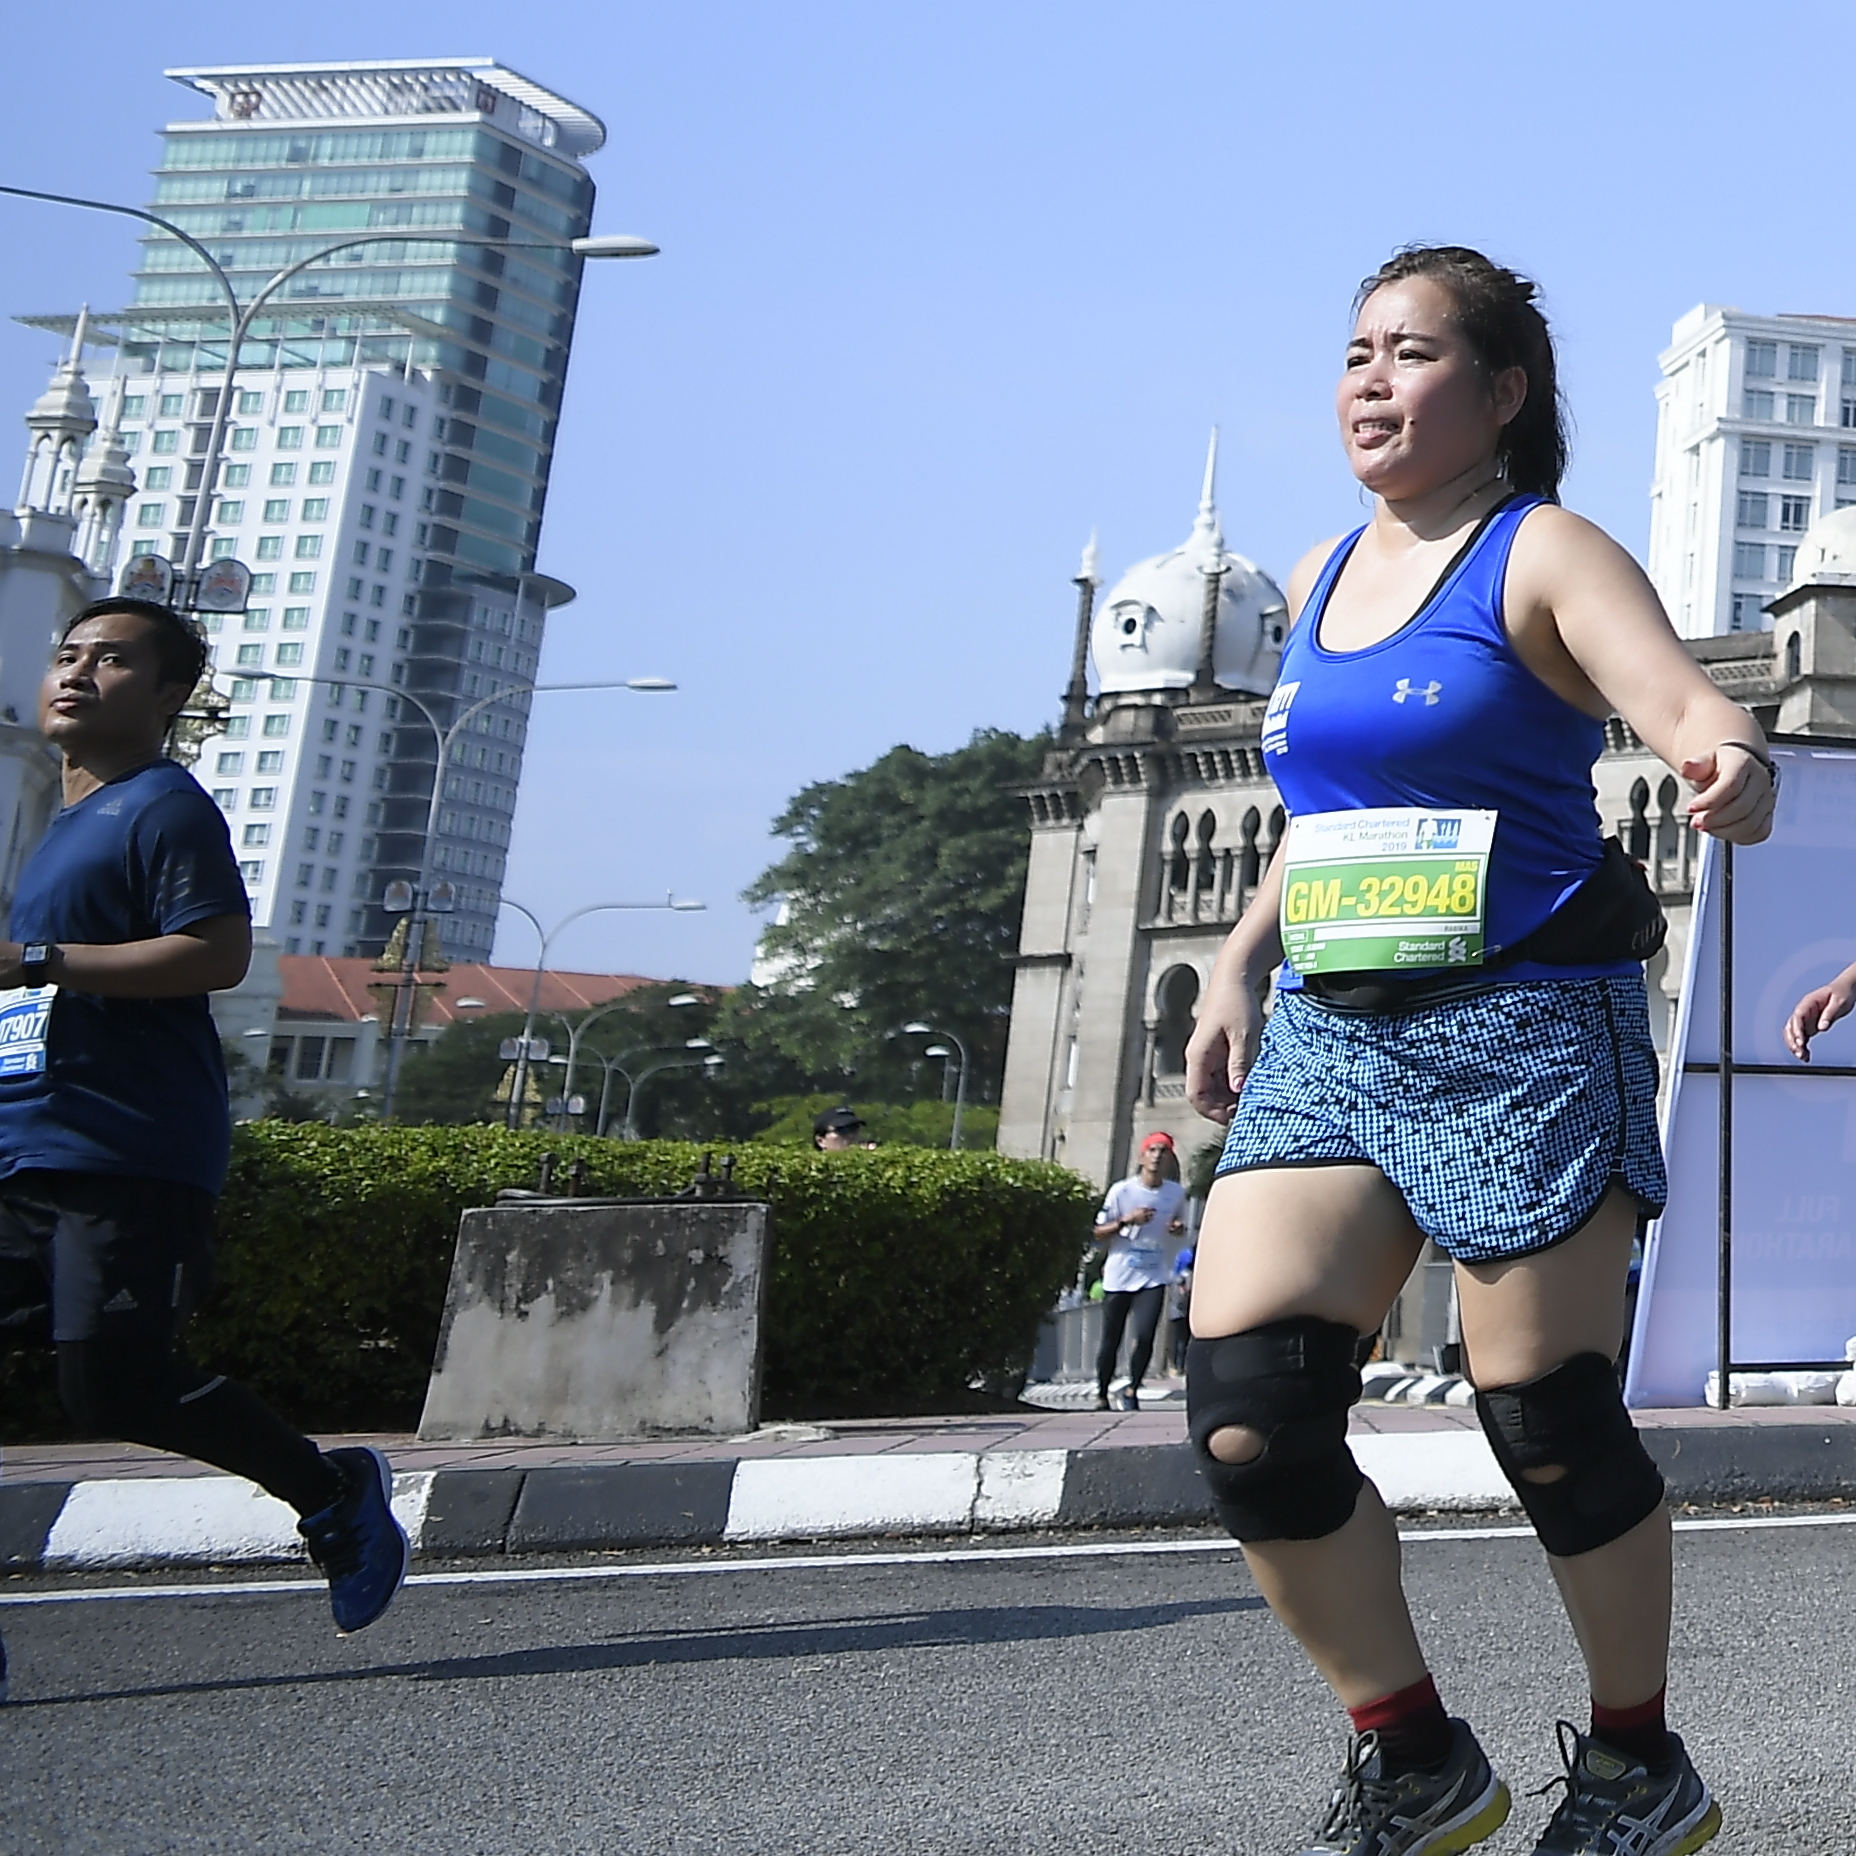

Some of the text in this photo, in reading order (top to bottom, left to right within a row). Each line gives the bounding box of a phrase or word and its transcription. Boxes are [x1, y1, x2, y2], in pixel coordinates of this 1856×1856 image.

[1382, 842, 1407, 852] 2019
[1286, 873, 1476, 923] GM-32948
[1398, 940, 1445, 951] Standard
[1394, 951, 1445, 963] Chartered
